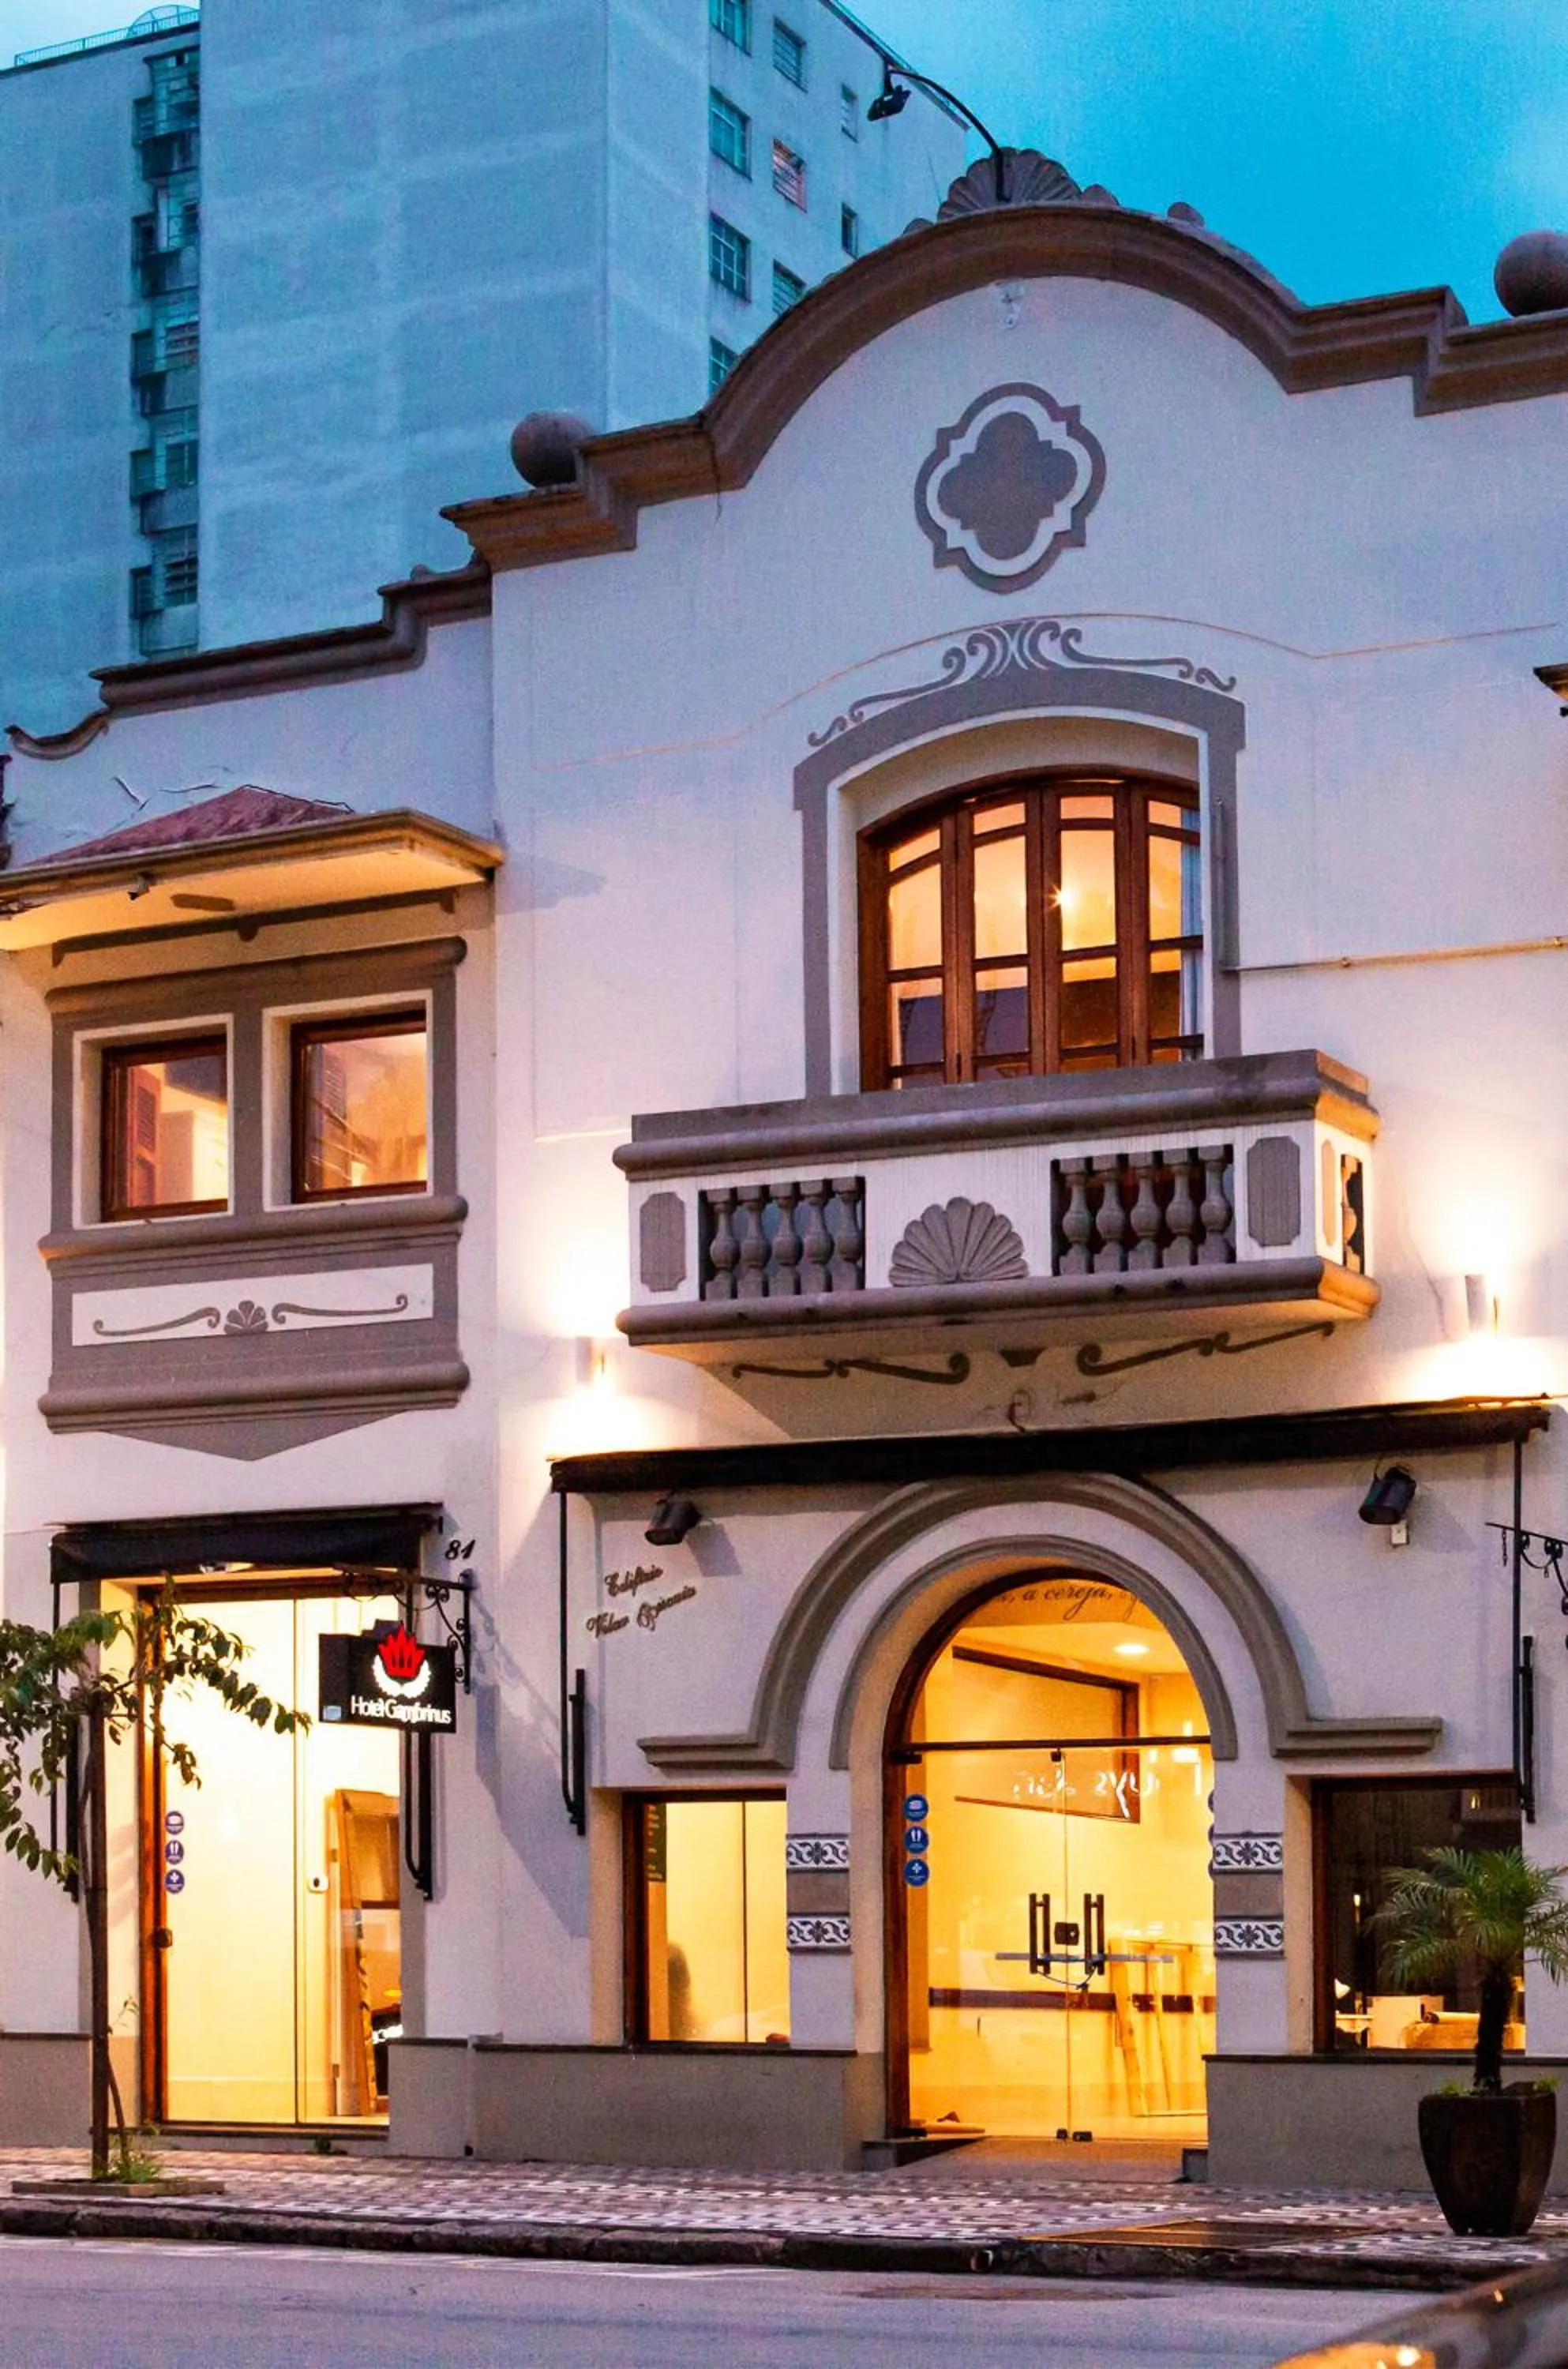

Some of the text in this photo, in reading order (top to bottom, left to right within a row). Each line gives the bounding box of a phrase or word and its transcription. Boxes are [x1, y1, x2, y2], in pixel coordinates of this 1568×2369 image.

[445, 1540, 475, 1560] 81
[351, 1695, 384, 1718] Hotel
[385, 1699, 452, 1724] Gambrinus
